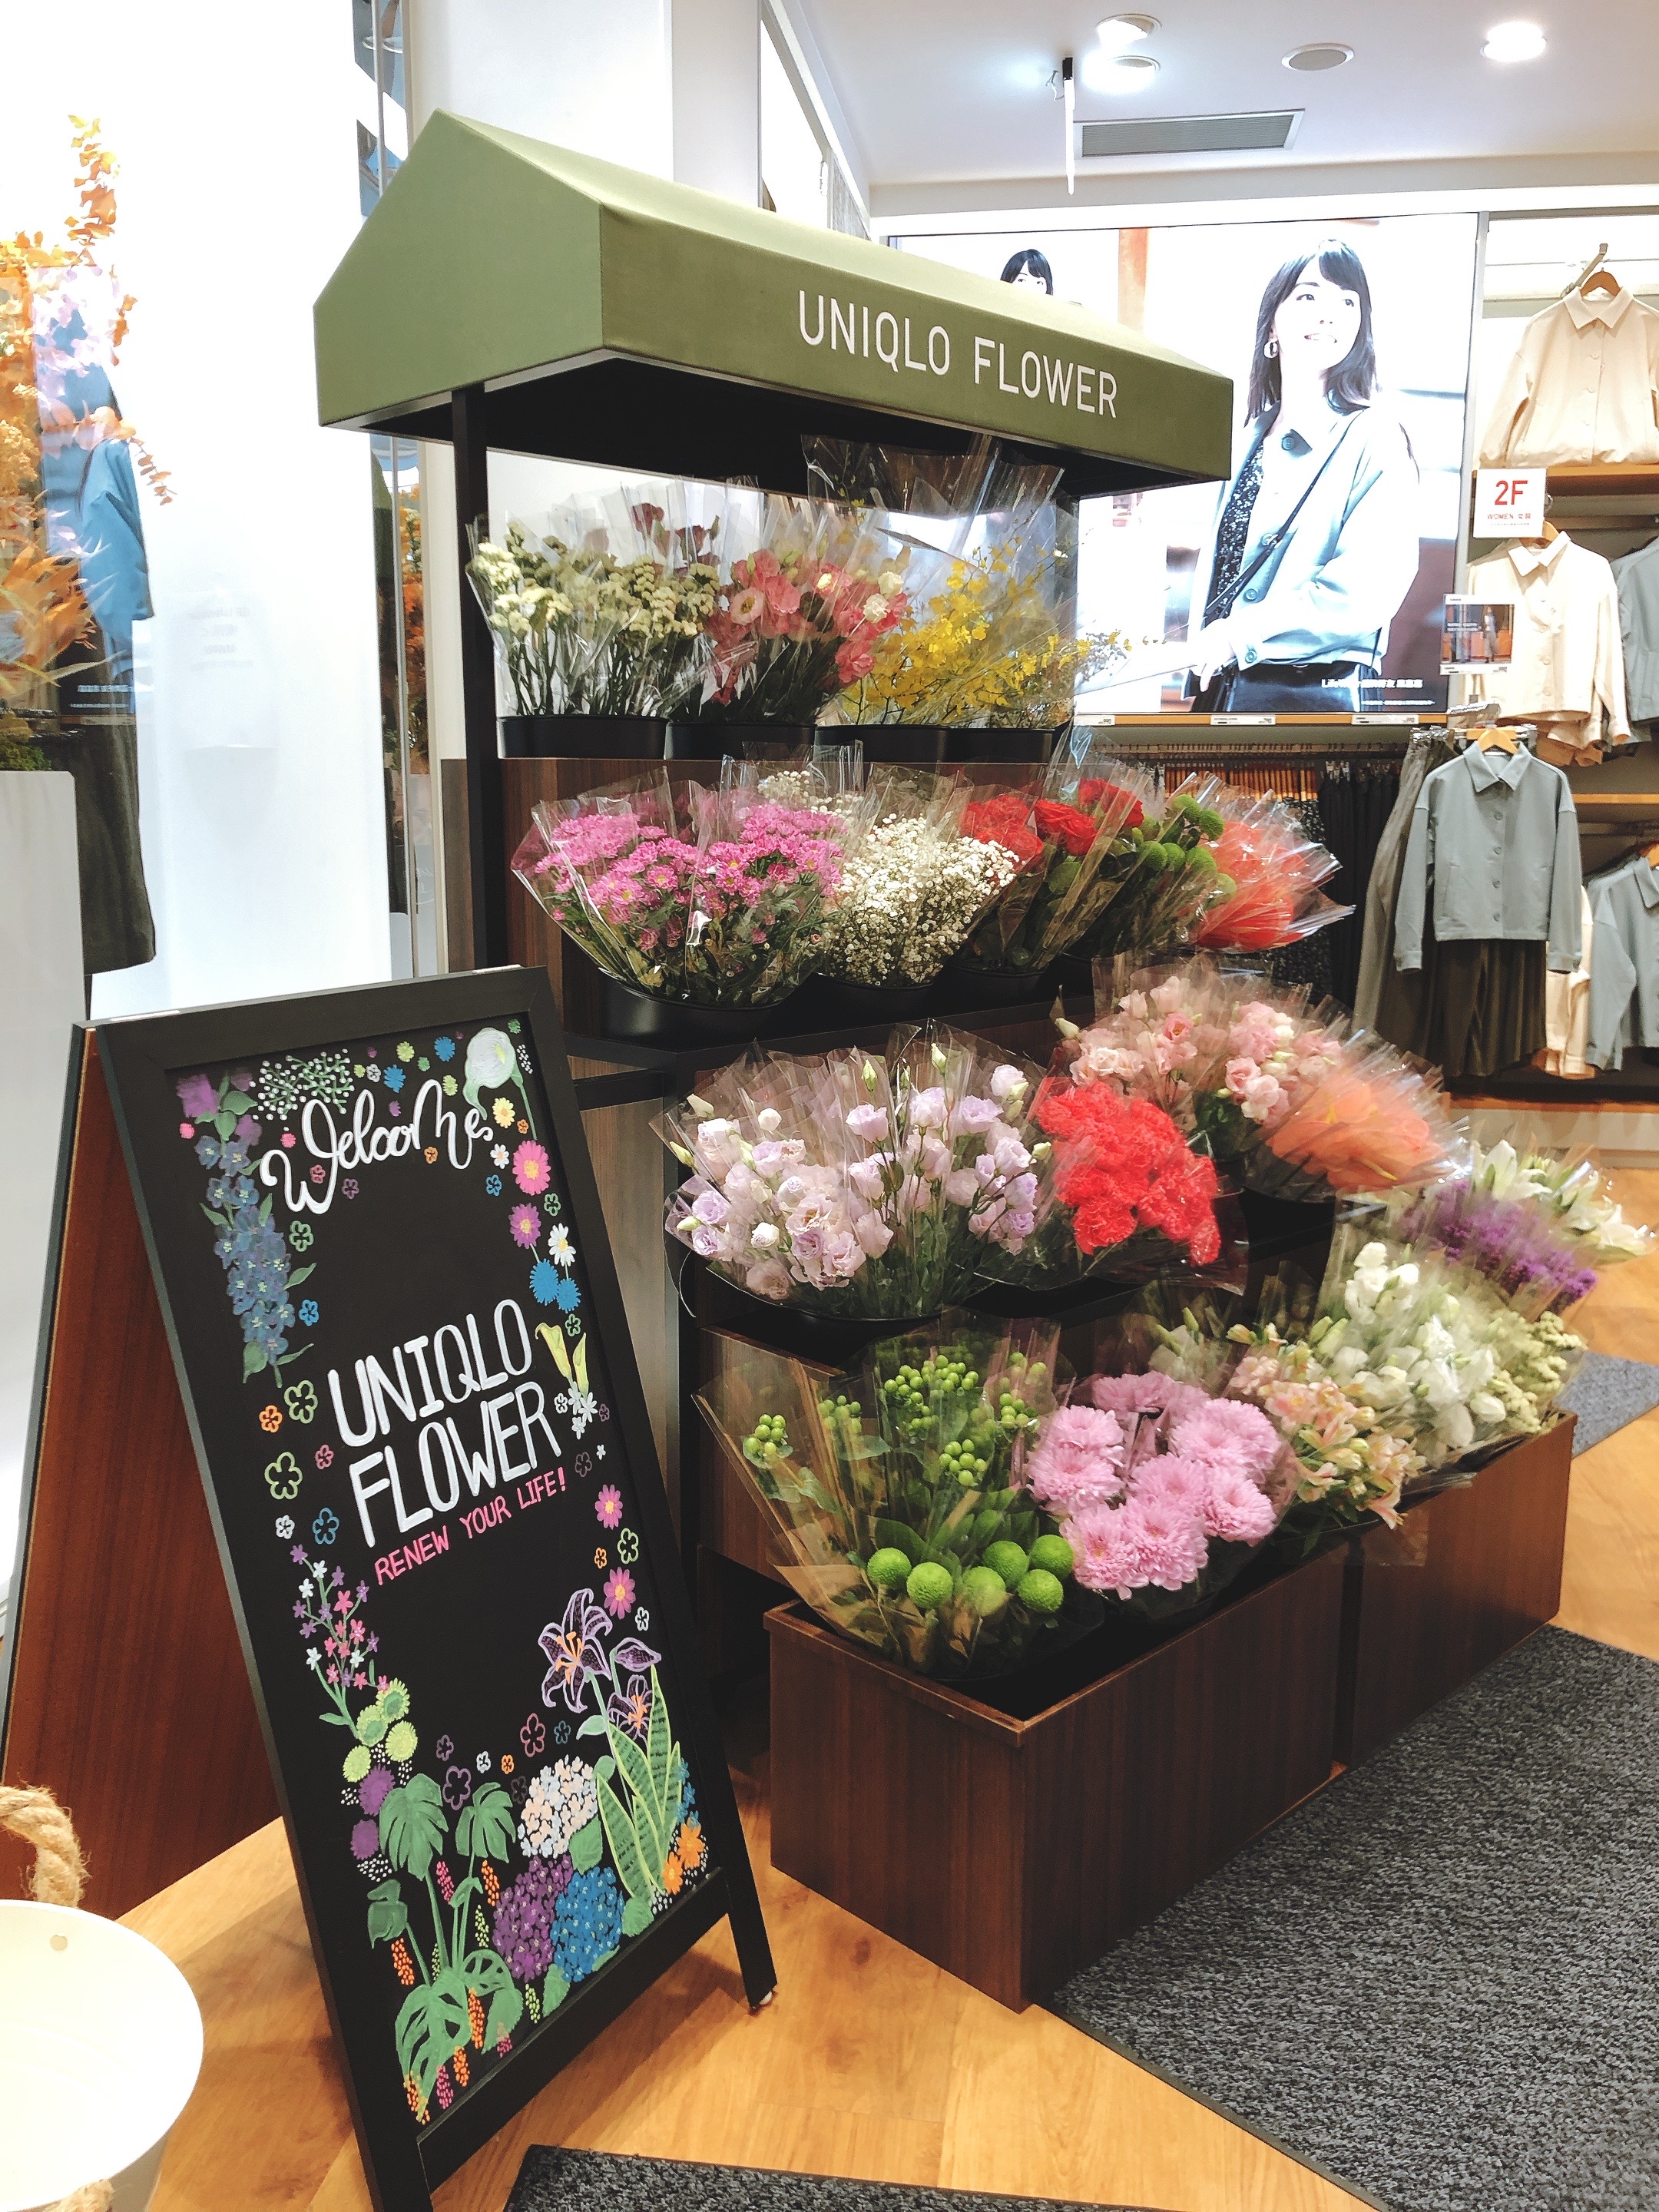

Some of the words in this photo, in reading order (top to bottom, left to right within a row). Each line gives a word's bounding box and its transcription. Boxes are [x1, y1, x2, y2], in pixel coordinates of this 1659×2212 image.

[800, 290, 950, 375] UNIQLO
[975, 336, 1118, 419] FLOWER
[1494, 480, 1528, 505] 2F
[260, 1079, 494, 1214] Welcome
[327, 1299, 532, 1447] UNIQLO
[349, 1381, 561, 1548] FLOWER
[373, 1525, 450, 1586] RENEW
[459, 1495, 512, 1539] YOUR
[517, 1466, 567, 1510] LIFE!
